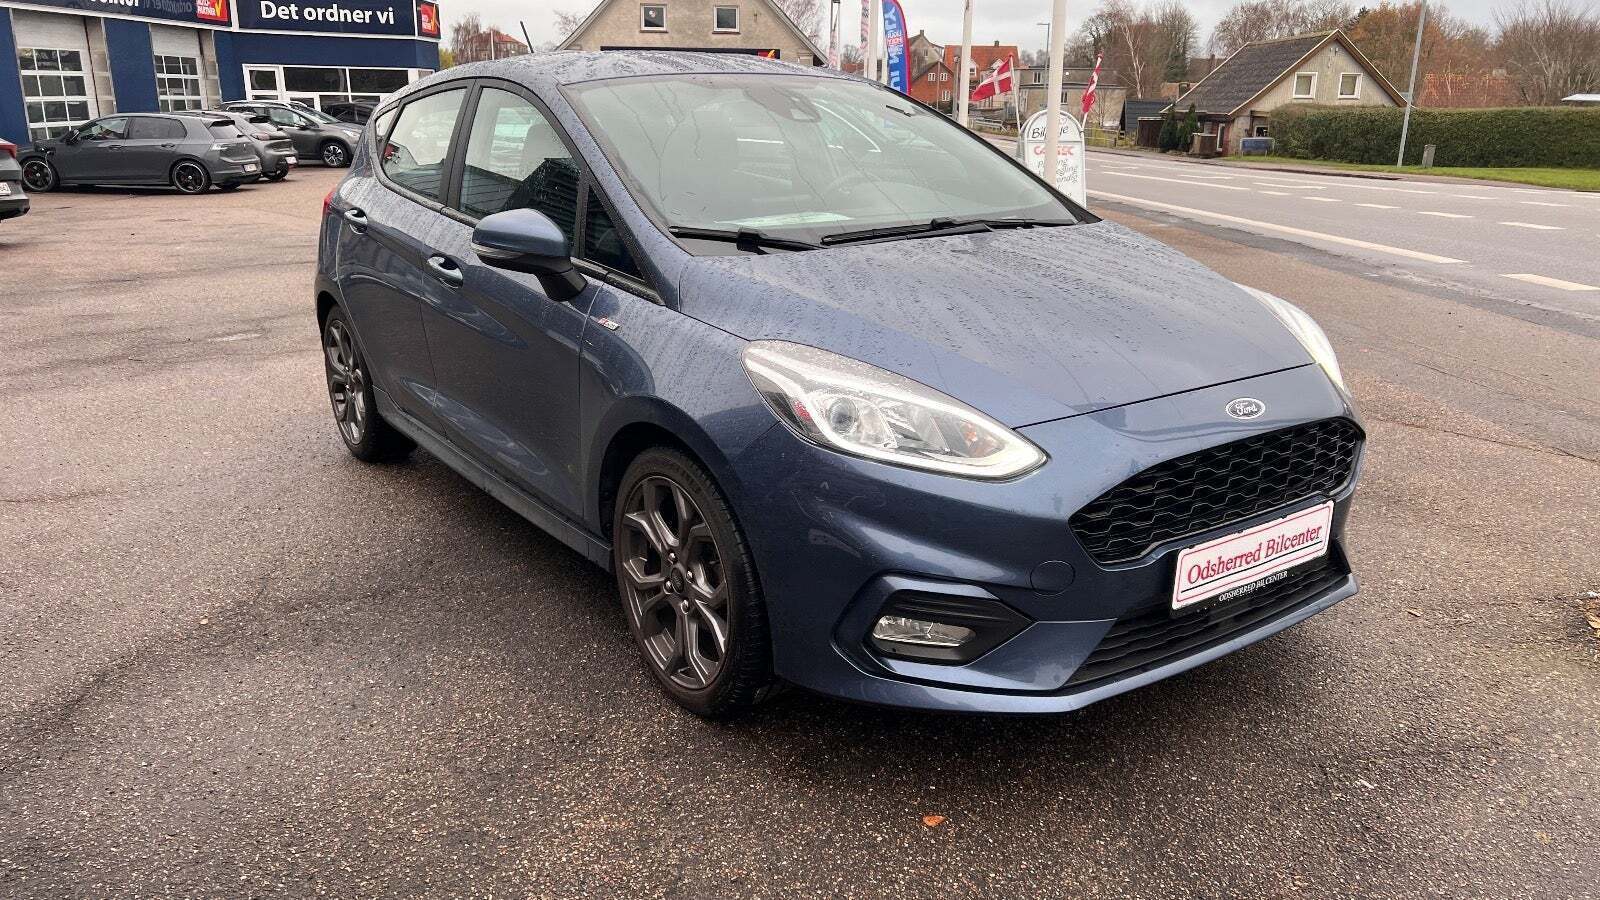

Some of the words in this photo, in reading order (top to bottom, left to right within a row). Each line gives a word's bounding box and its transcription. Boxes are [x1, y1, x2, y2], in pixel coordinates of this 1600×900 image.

[260, 1, 299, 19] Det
[303, 4, 372, 23] ordner
[376, 7, 395, 24] vi
[1235, 402, 1257, 415] Ford
[1188, 542, 1262, 584] Odsherred
[1264, 525, 1322, 558] Bilcenter
[1219, 582, 1256, 601] ODSHERRED
